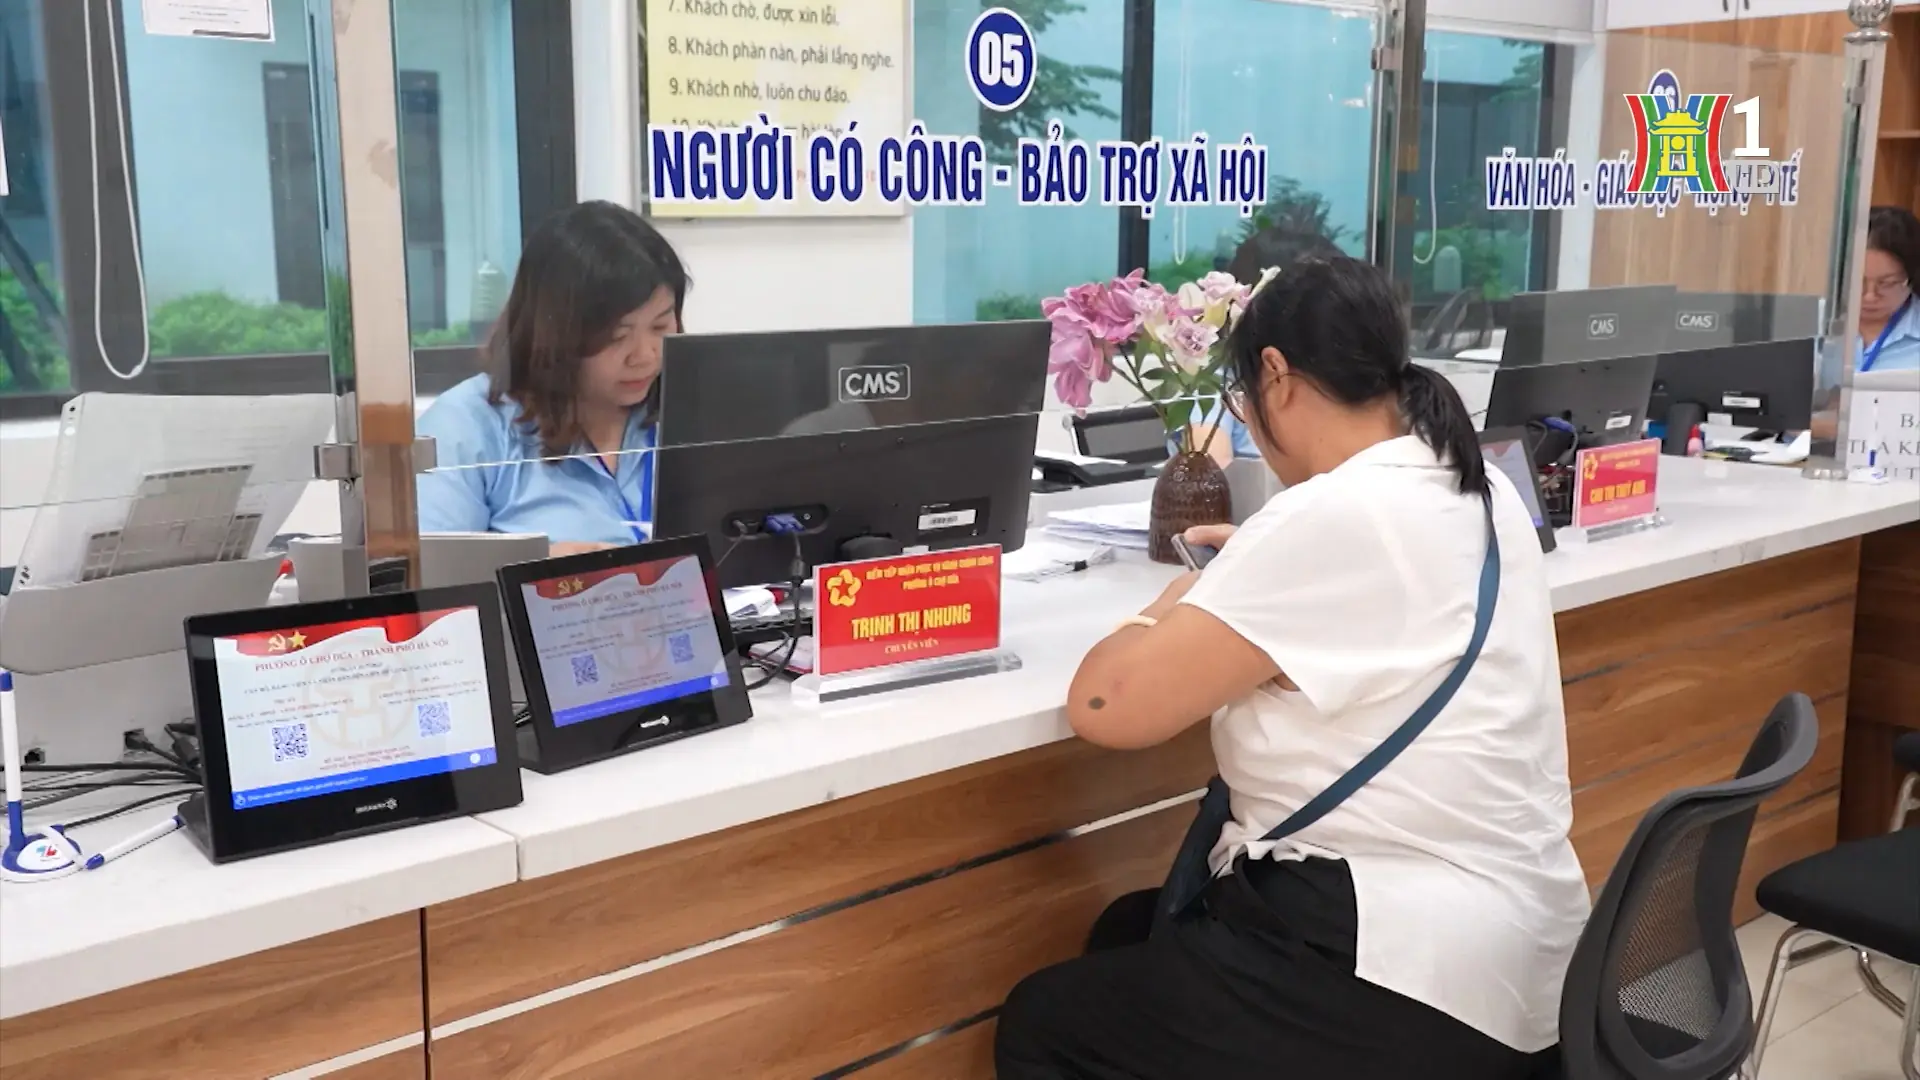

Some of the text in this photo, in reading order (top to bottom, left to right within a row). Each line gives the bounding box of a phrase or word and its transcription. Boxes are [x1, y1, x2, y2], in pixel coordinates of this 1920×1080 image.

[685, 0, 728, 17] Khách
[764, 4, 793, 25] được
[799, 8, 818, 24] xin
[668, 36, 682, 55] 8.
[686, 37, 729, 58] Khách
[801, 43, 828, 66] phải
[832, 45, 858, 69] lắng
[861, 51, 894, 71] nghe.
[979, 31, 1025, 87] 05
[669, 78, 682, 96] 9.
[687, 79, 729, 98] Khách
[767, 82, 794, 100] luôn
[798, 84, 820, 102] chu
[824, 83, 850, 104] đáo.
[652, 113, 793, 201] NGƯỜI
[810, 121, 863, 202] CÓ
[880, 125, 982, 202] CÔNG
[1023, 123, 1087, 202] BẢO
[1100, 141, 1160, 214] TRỢ
[1170, 137, 1209, 202] XÃ
[1220, 136, 1266, 214] HỘI
[1488, 152, 1530, 206] VĂN
[1536, 151, 1575, 206] HÓA
[1589, 318, 1614, 335] CMS
[1679, 313, 1713, 329] CMS
[844, 371, 902, 396] CMS
[852, 603, 972, 642] TRỊNH THỊ NHUNG
